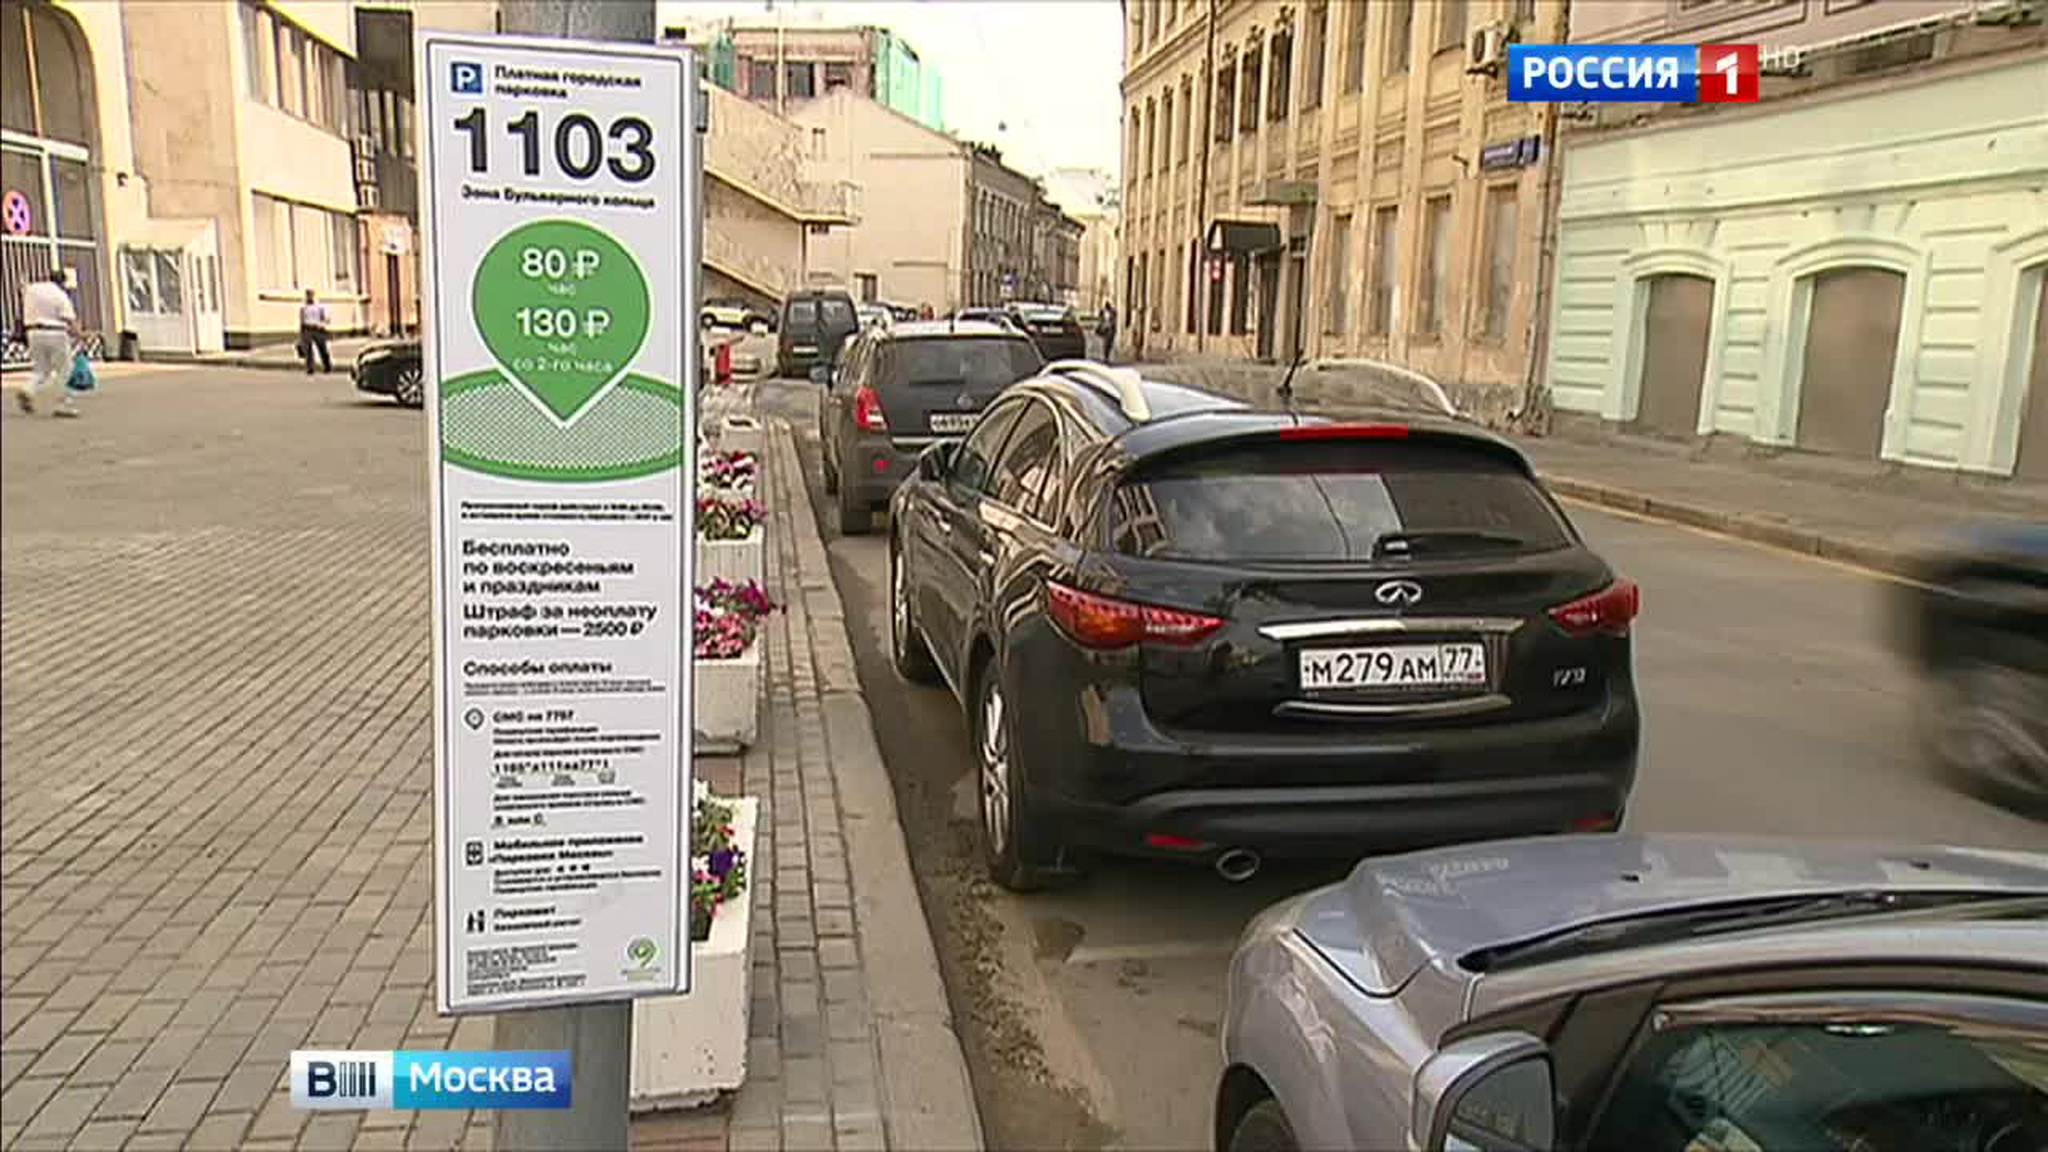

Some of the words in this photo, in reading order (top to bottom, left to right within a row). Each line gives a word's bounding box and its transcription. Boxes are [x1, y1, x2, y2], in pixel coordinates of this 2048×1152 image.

[495, 65, 559, 81] Платная
[563, 71, 641, 88] городская
[495, 84, 567, 98] парковка
[454, 106, 656, 183] 1103
[462, 184, 500, 199] Зона
[504, 187, 600, 206] Бульварного
[604, 197, 655, 209] кольца
[522, 247, 567, 278] 80
[516, 307, 577, 337] 130
[463, 540, 570, 556] Бесплатно
[463, 563, 489, 575] по
[493, 561, 634, 577] воскресеньям
[463, 582, 476, 594] и
[481, 581, 600, 596] праздникам
[463, 603, 537, 621] Штраф
[542, 607, 564, 618] за
[568, 605, 657, 621] неоплату
[463, 624, 558, 640] парковки
[583, 621, 627, 637] 2500
[463, 660, 545, 677] Способы
[548, 664, 613, 674] оплаты
[527, 713, 543, 721] на
